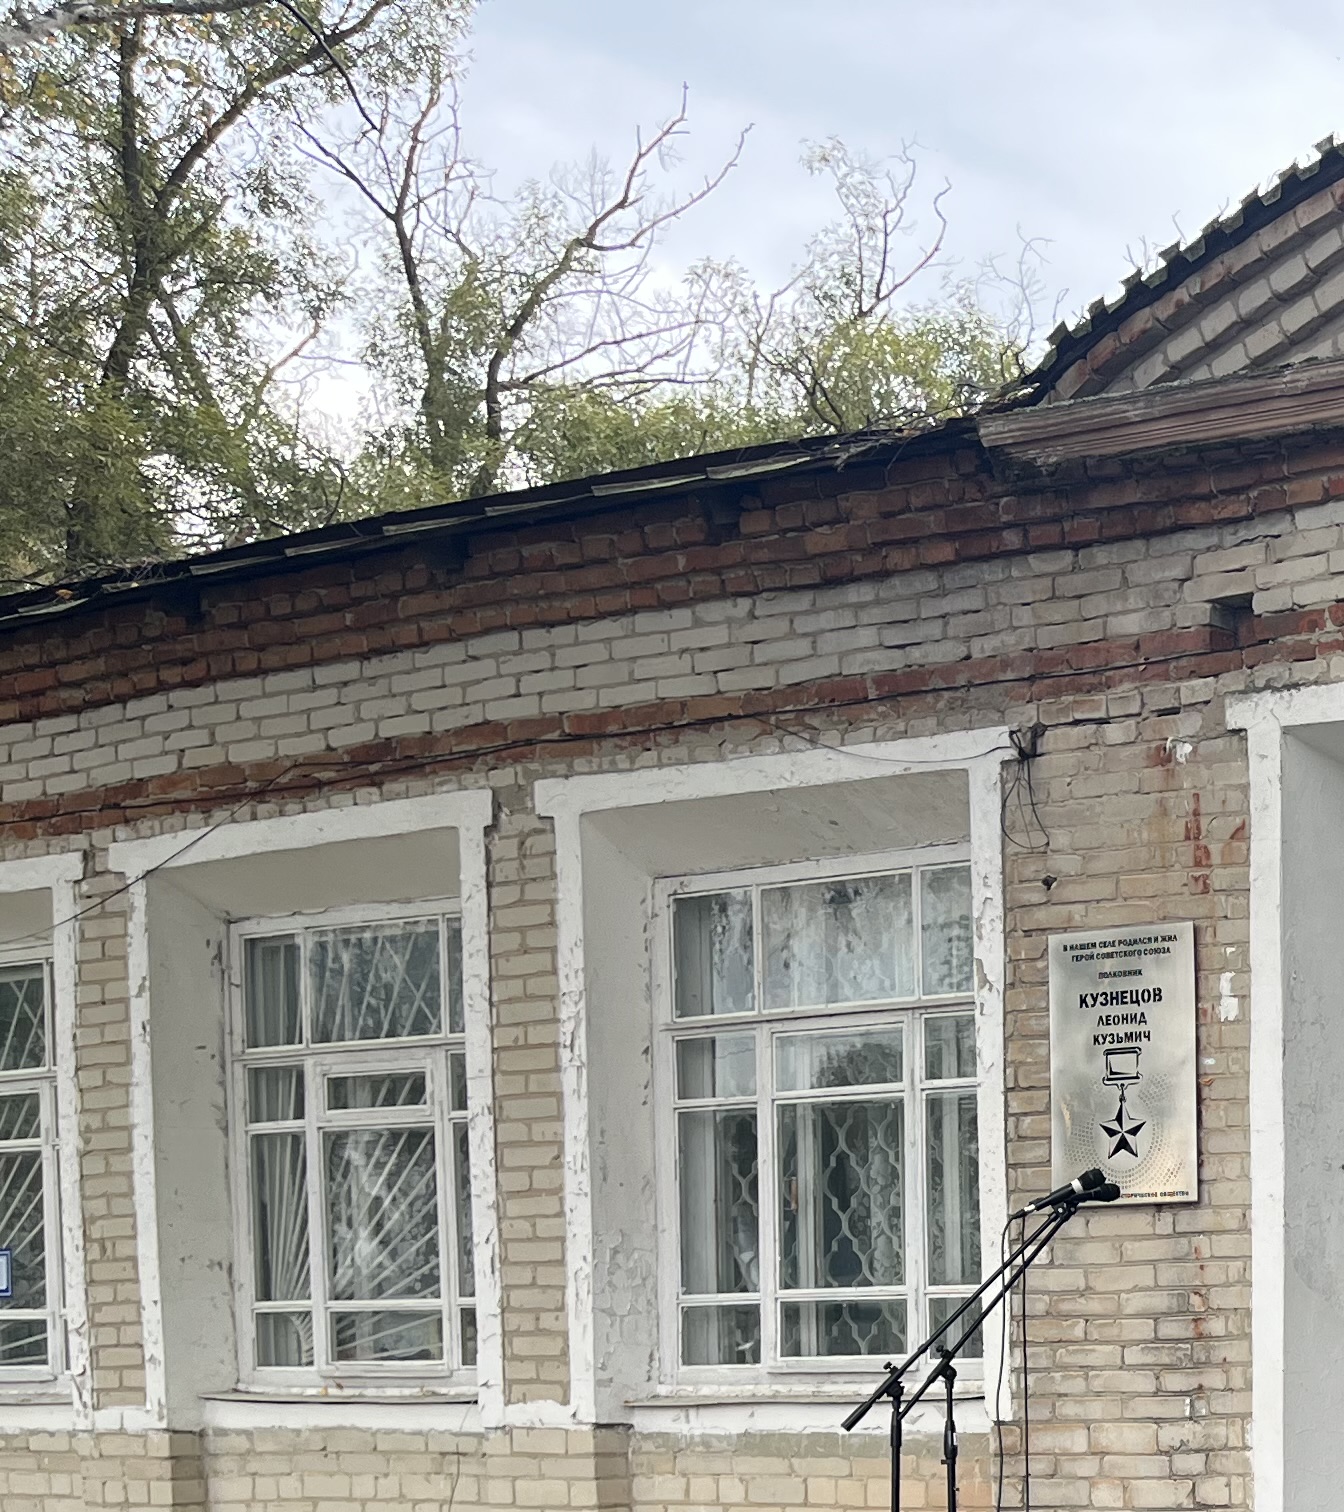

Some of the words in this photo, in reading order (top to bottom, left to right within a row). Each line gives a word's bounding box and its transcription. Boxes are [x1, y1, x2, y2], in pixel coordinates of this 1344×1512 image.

[1069, 942, 1097, 951] НАШЕМ
[1098, 940, 1116, 949] СЕЛЕ
[1118, 937, 1153, 947] РОДИЛСЯ
[1160, 934, 1178, 942] ЖИЛ
[1072, 951, 1094, 962] ГЕРОЙ
[1096, 949, 1142, 960] СОВЕТСКОГО
[1144, 947, 1171, 956] СОЮЗА
[1098, 969, 1143, 979] ПОЛКОВНИК
[1079, 987, 1163, 1009] КУЗНЕЦОВ
[1096, 1011, 1148, 1027] ЛЕОНИД
[1093, 1030, 1151, 1046] КУЗЬМИЧ
